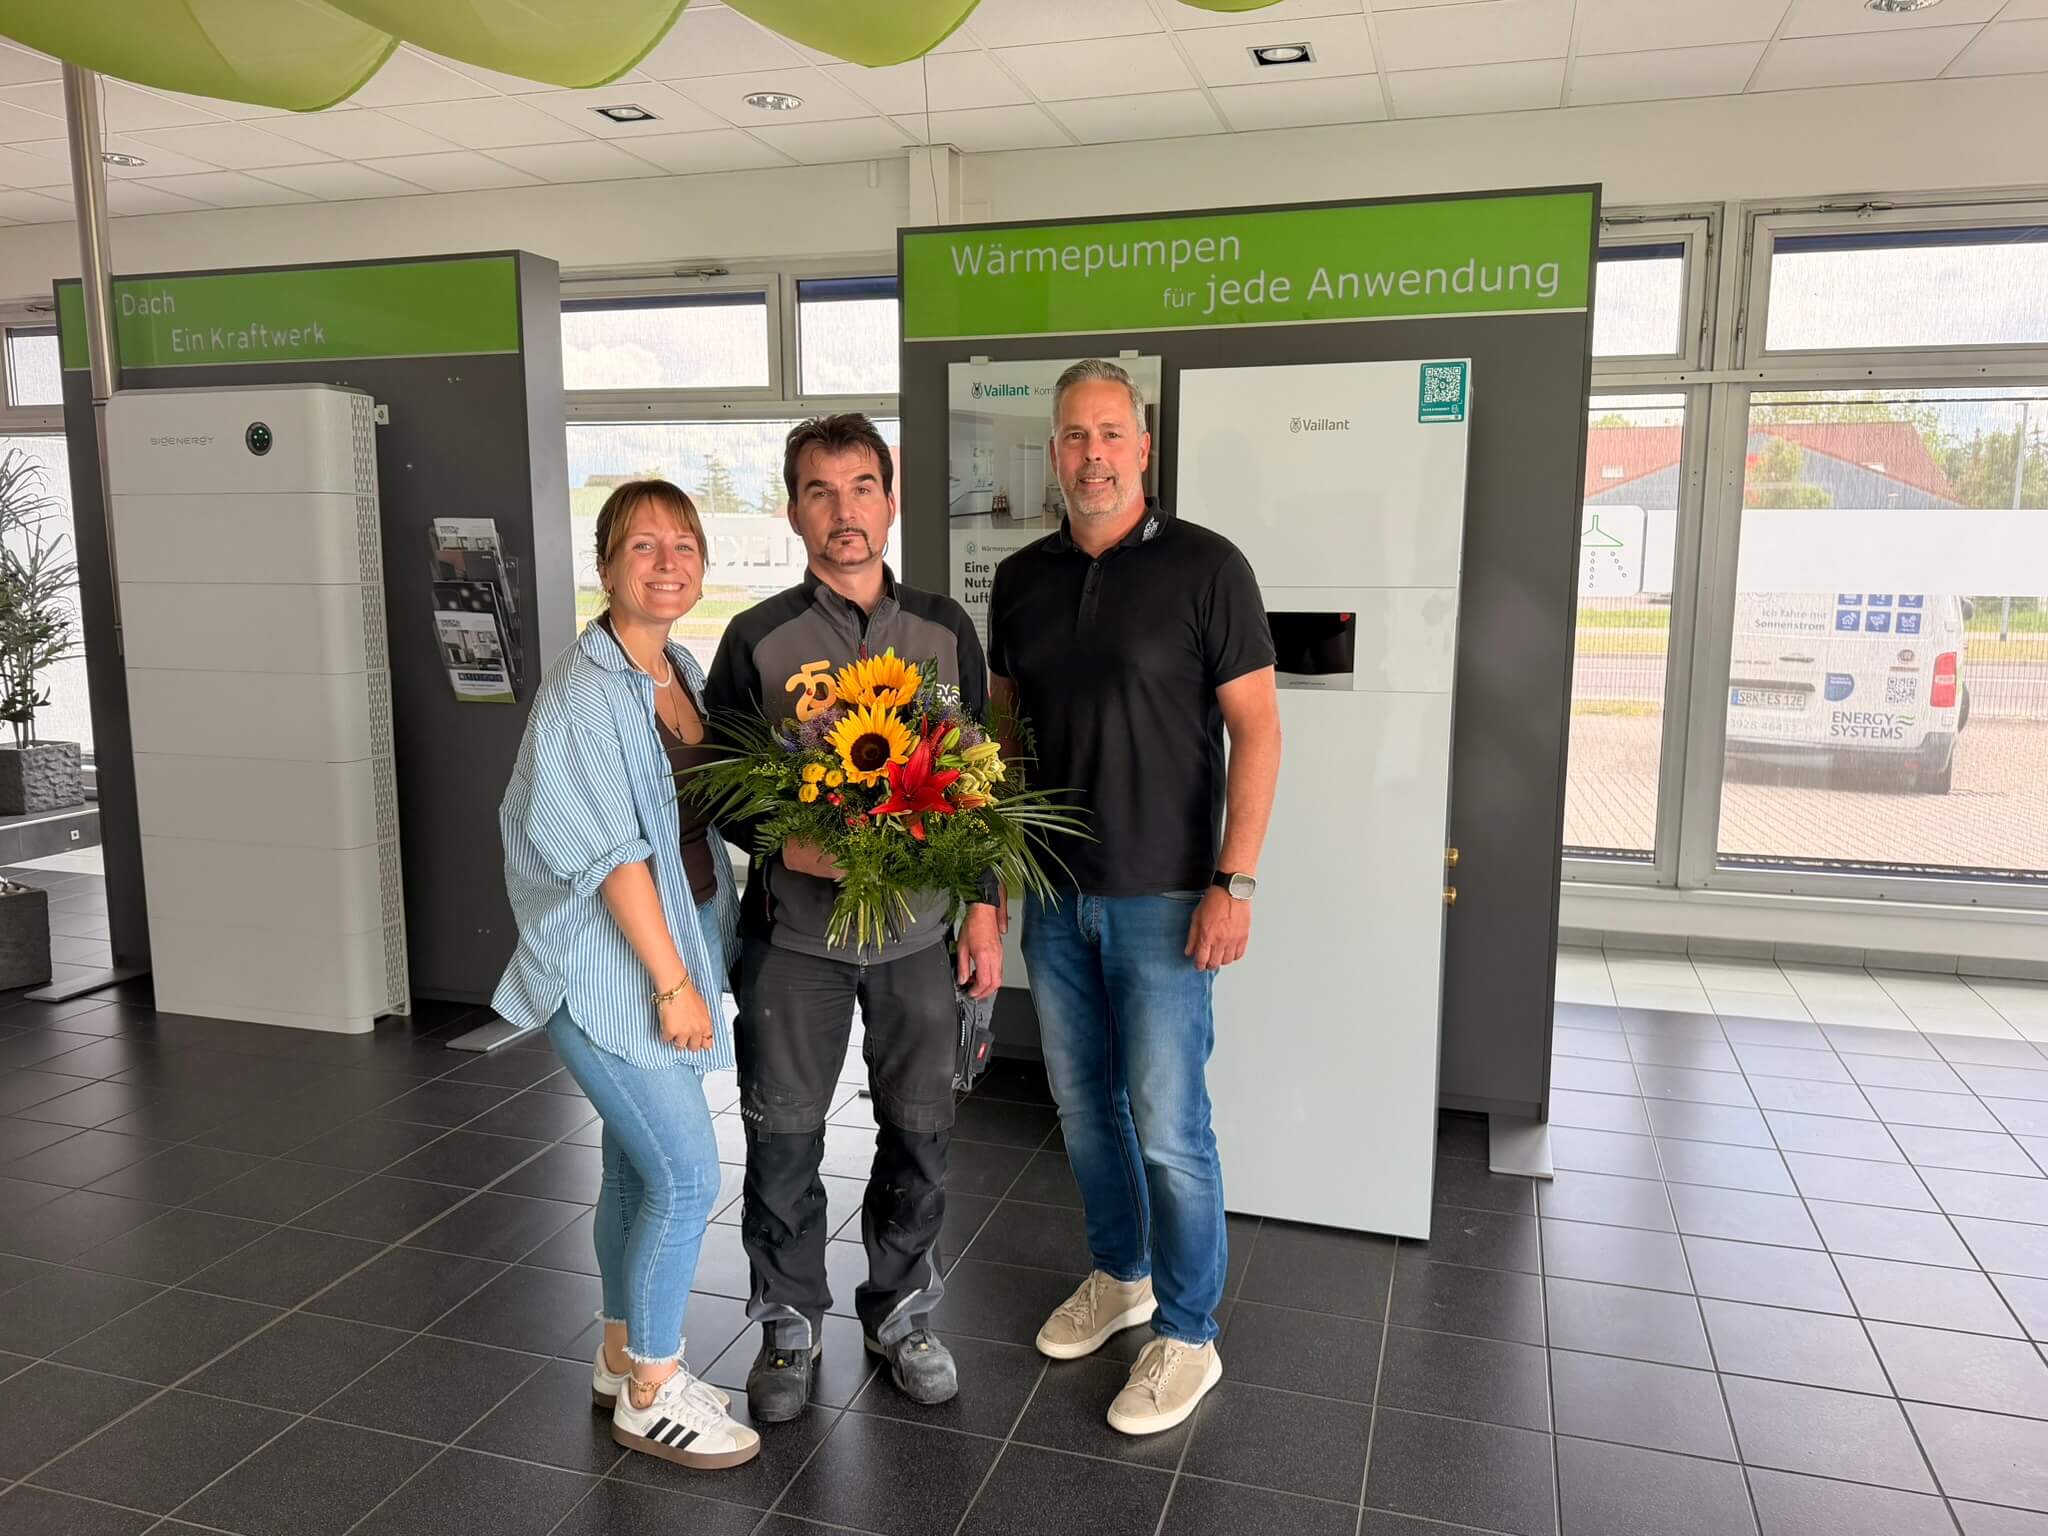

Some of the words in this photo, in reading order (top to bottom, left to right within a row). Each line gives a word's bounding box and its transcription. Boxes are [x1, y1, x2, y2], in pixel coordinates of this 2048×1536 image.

[951, 235, 1240, 277] Wärmepumpen
[1163, 287, 1197, 308] für
[1202, 269, 1291, 315] jede
[1307, 258, 1560, 299] Anwendung
[121, 290, 175, 317] Dach
[171, 327, 204, 352] Ein
[210, 320, 326, 350] Kraftwerk
[983, 384, 1030, 397] Vaillant
[1302, 419, 1350, 431] Vaillant
[964, 560, 990, 573] Eine
[964, 577, 992, 588] Nutz
[964, 591, 989, 604] Luft
[1754, 618, 1825, 631] Sonnenstrom
[785, 660, 837, 721] 25
[1832, 711, 1895, 725] ENERGY
[1831, 725, 1904, 740] SYSTEMS
